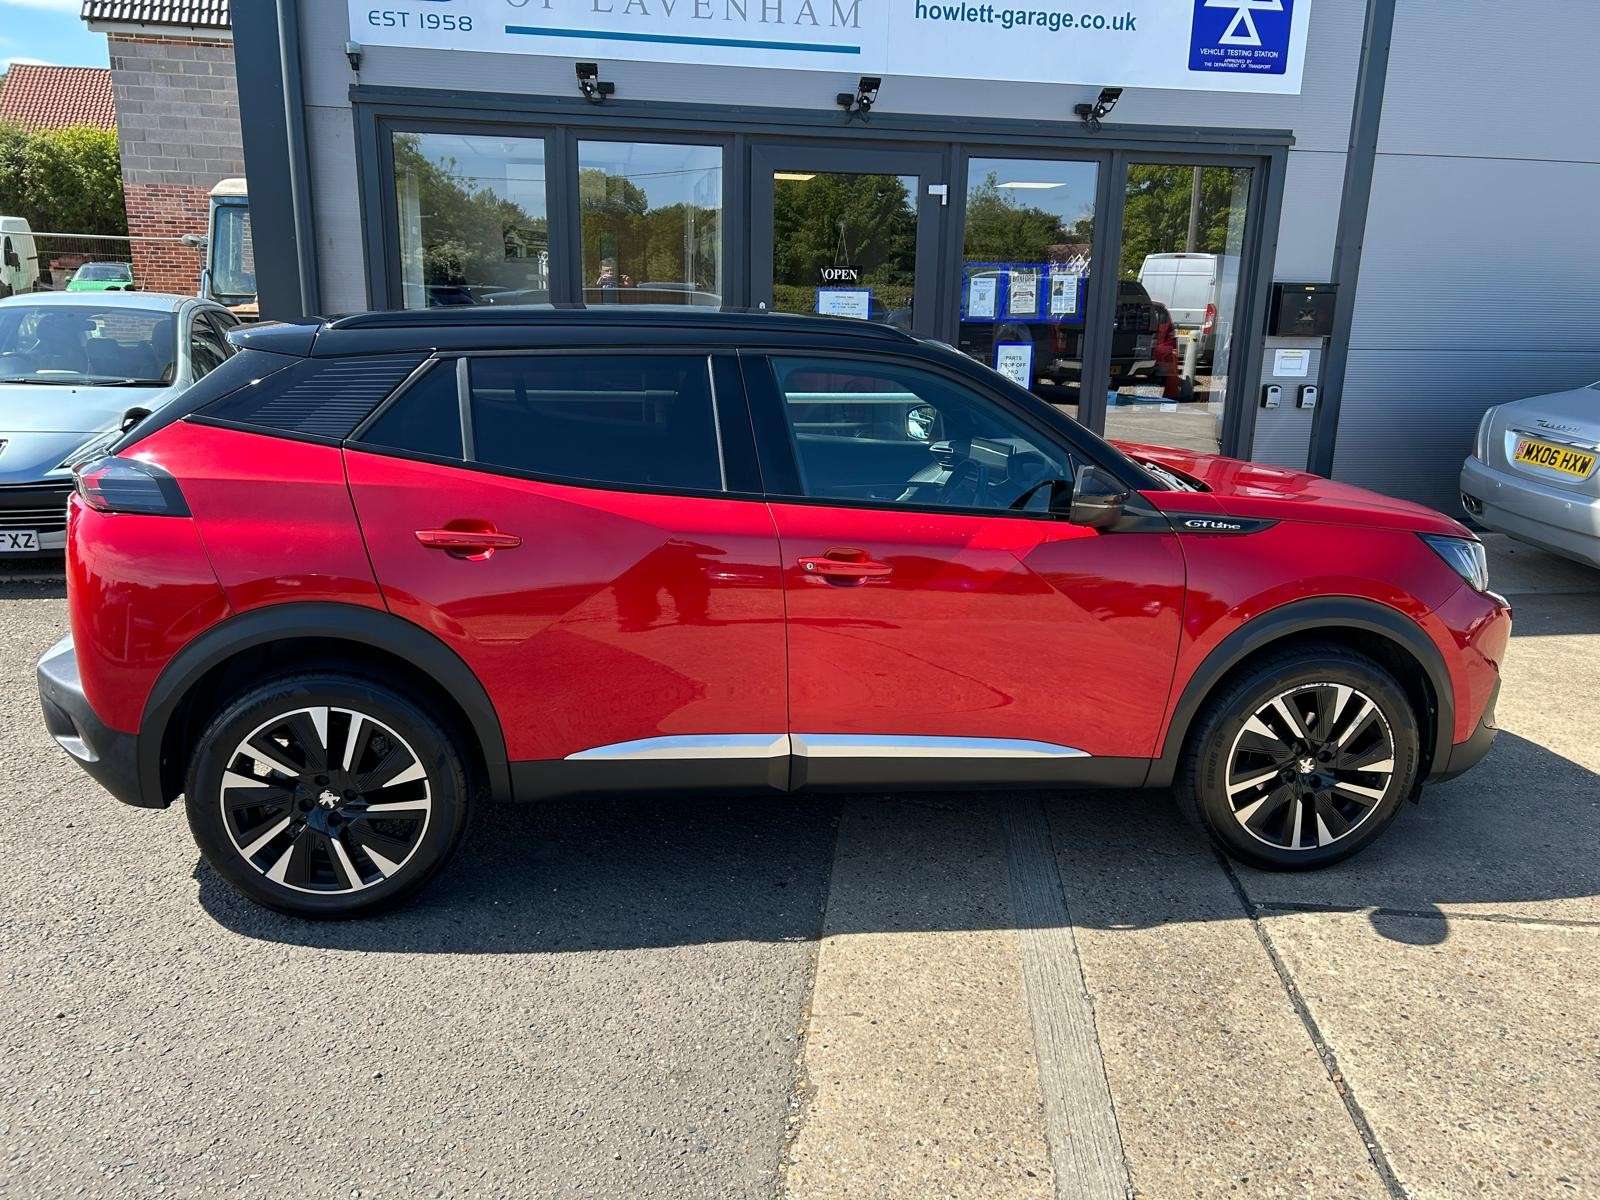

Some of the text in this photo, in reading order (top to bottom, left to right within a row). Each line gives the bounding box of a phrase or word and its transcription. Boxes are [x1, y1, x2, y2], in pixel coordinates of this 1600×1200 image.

[368, 10, 473, 32] EST 1958
[914, 0, 1137, 32] howlett-garage.co.uk
[1200, 48, 1279, 58] VEHICLE TESTING STATION
[824, 268, 858, 280] OPEN
[1523, 443, 1592, 473] MX06 HXW
